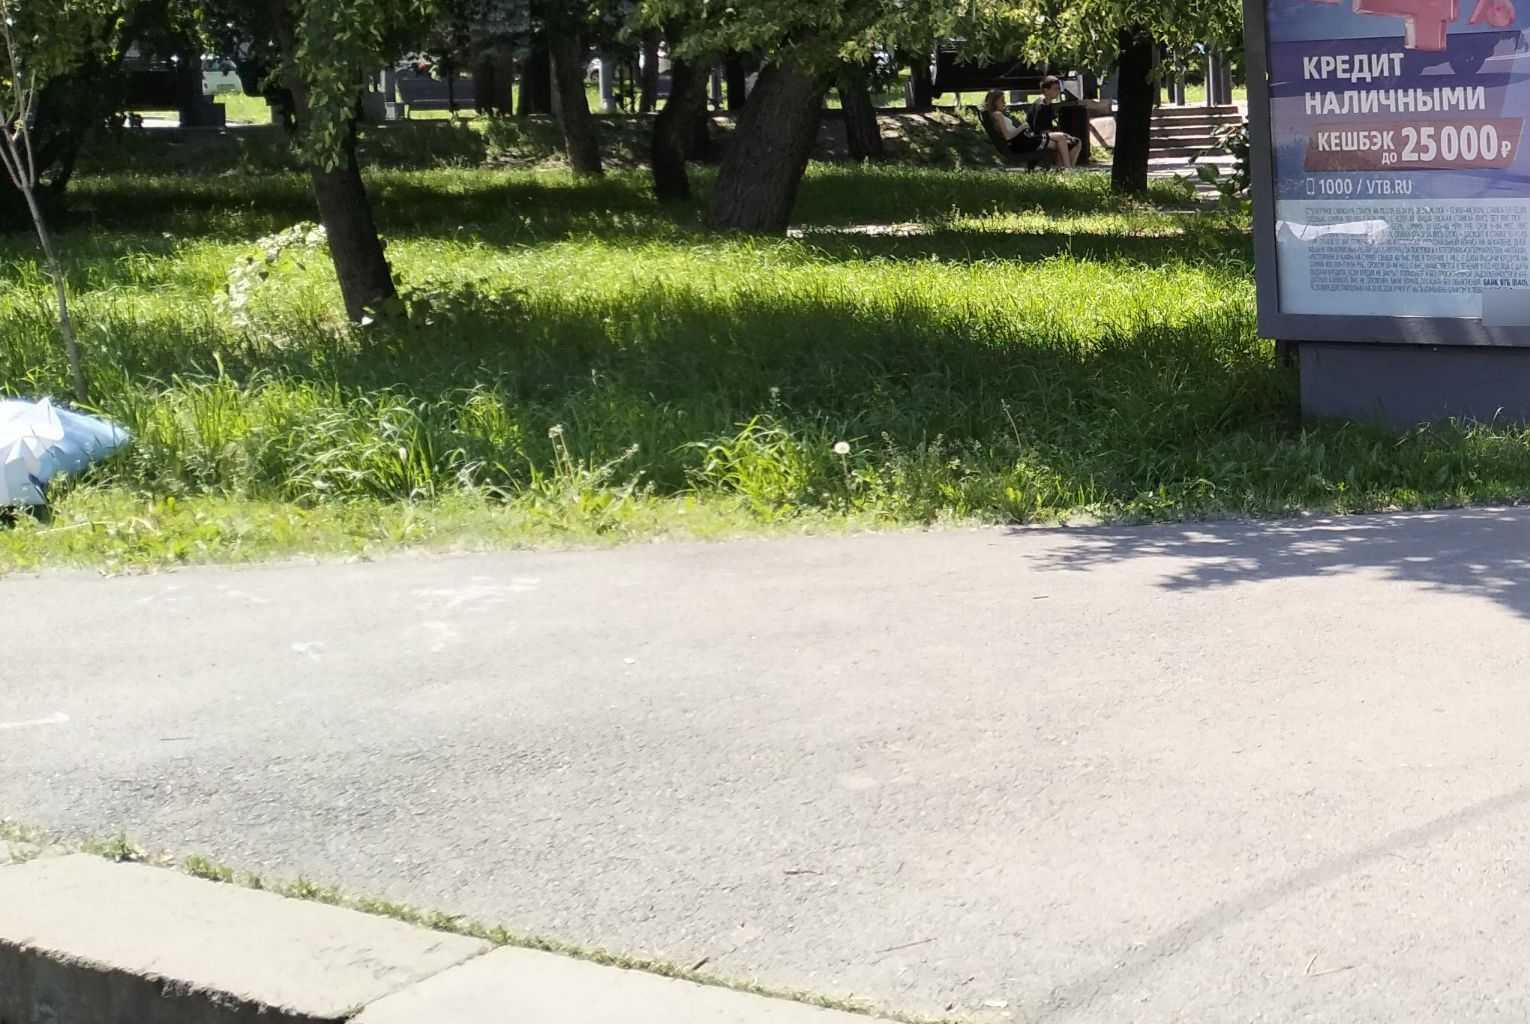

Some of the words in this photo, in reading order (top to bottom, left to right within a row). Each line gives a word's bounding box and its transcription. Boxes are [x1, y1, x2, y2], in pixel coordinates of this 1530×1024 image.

[1303, 53, 1405, 83] КРЕДИТ
[1304, 85, 1487, 115] НАЛИЧНЫМИ
[1317, 131, 1396, 152] КЕШБЭК
[1381, 152, 1398, 165] ДО
[1318, 179, 1353, 195] 1000
[1367, 178, 1413, 195] VTB.RU
